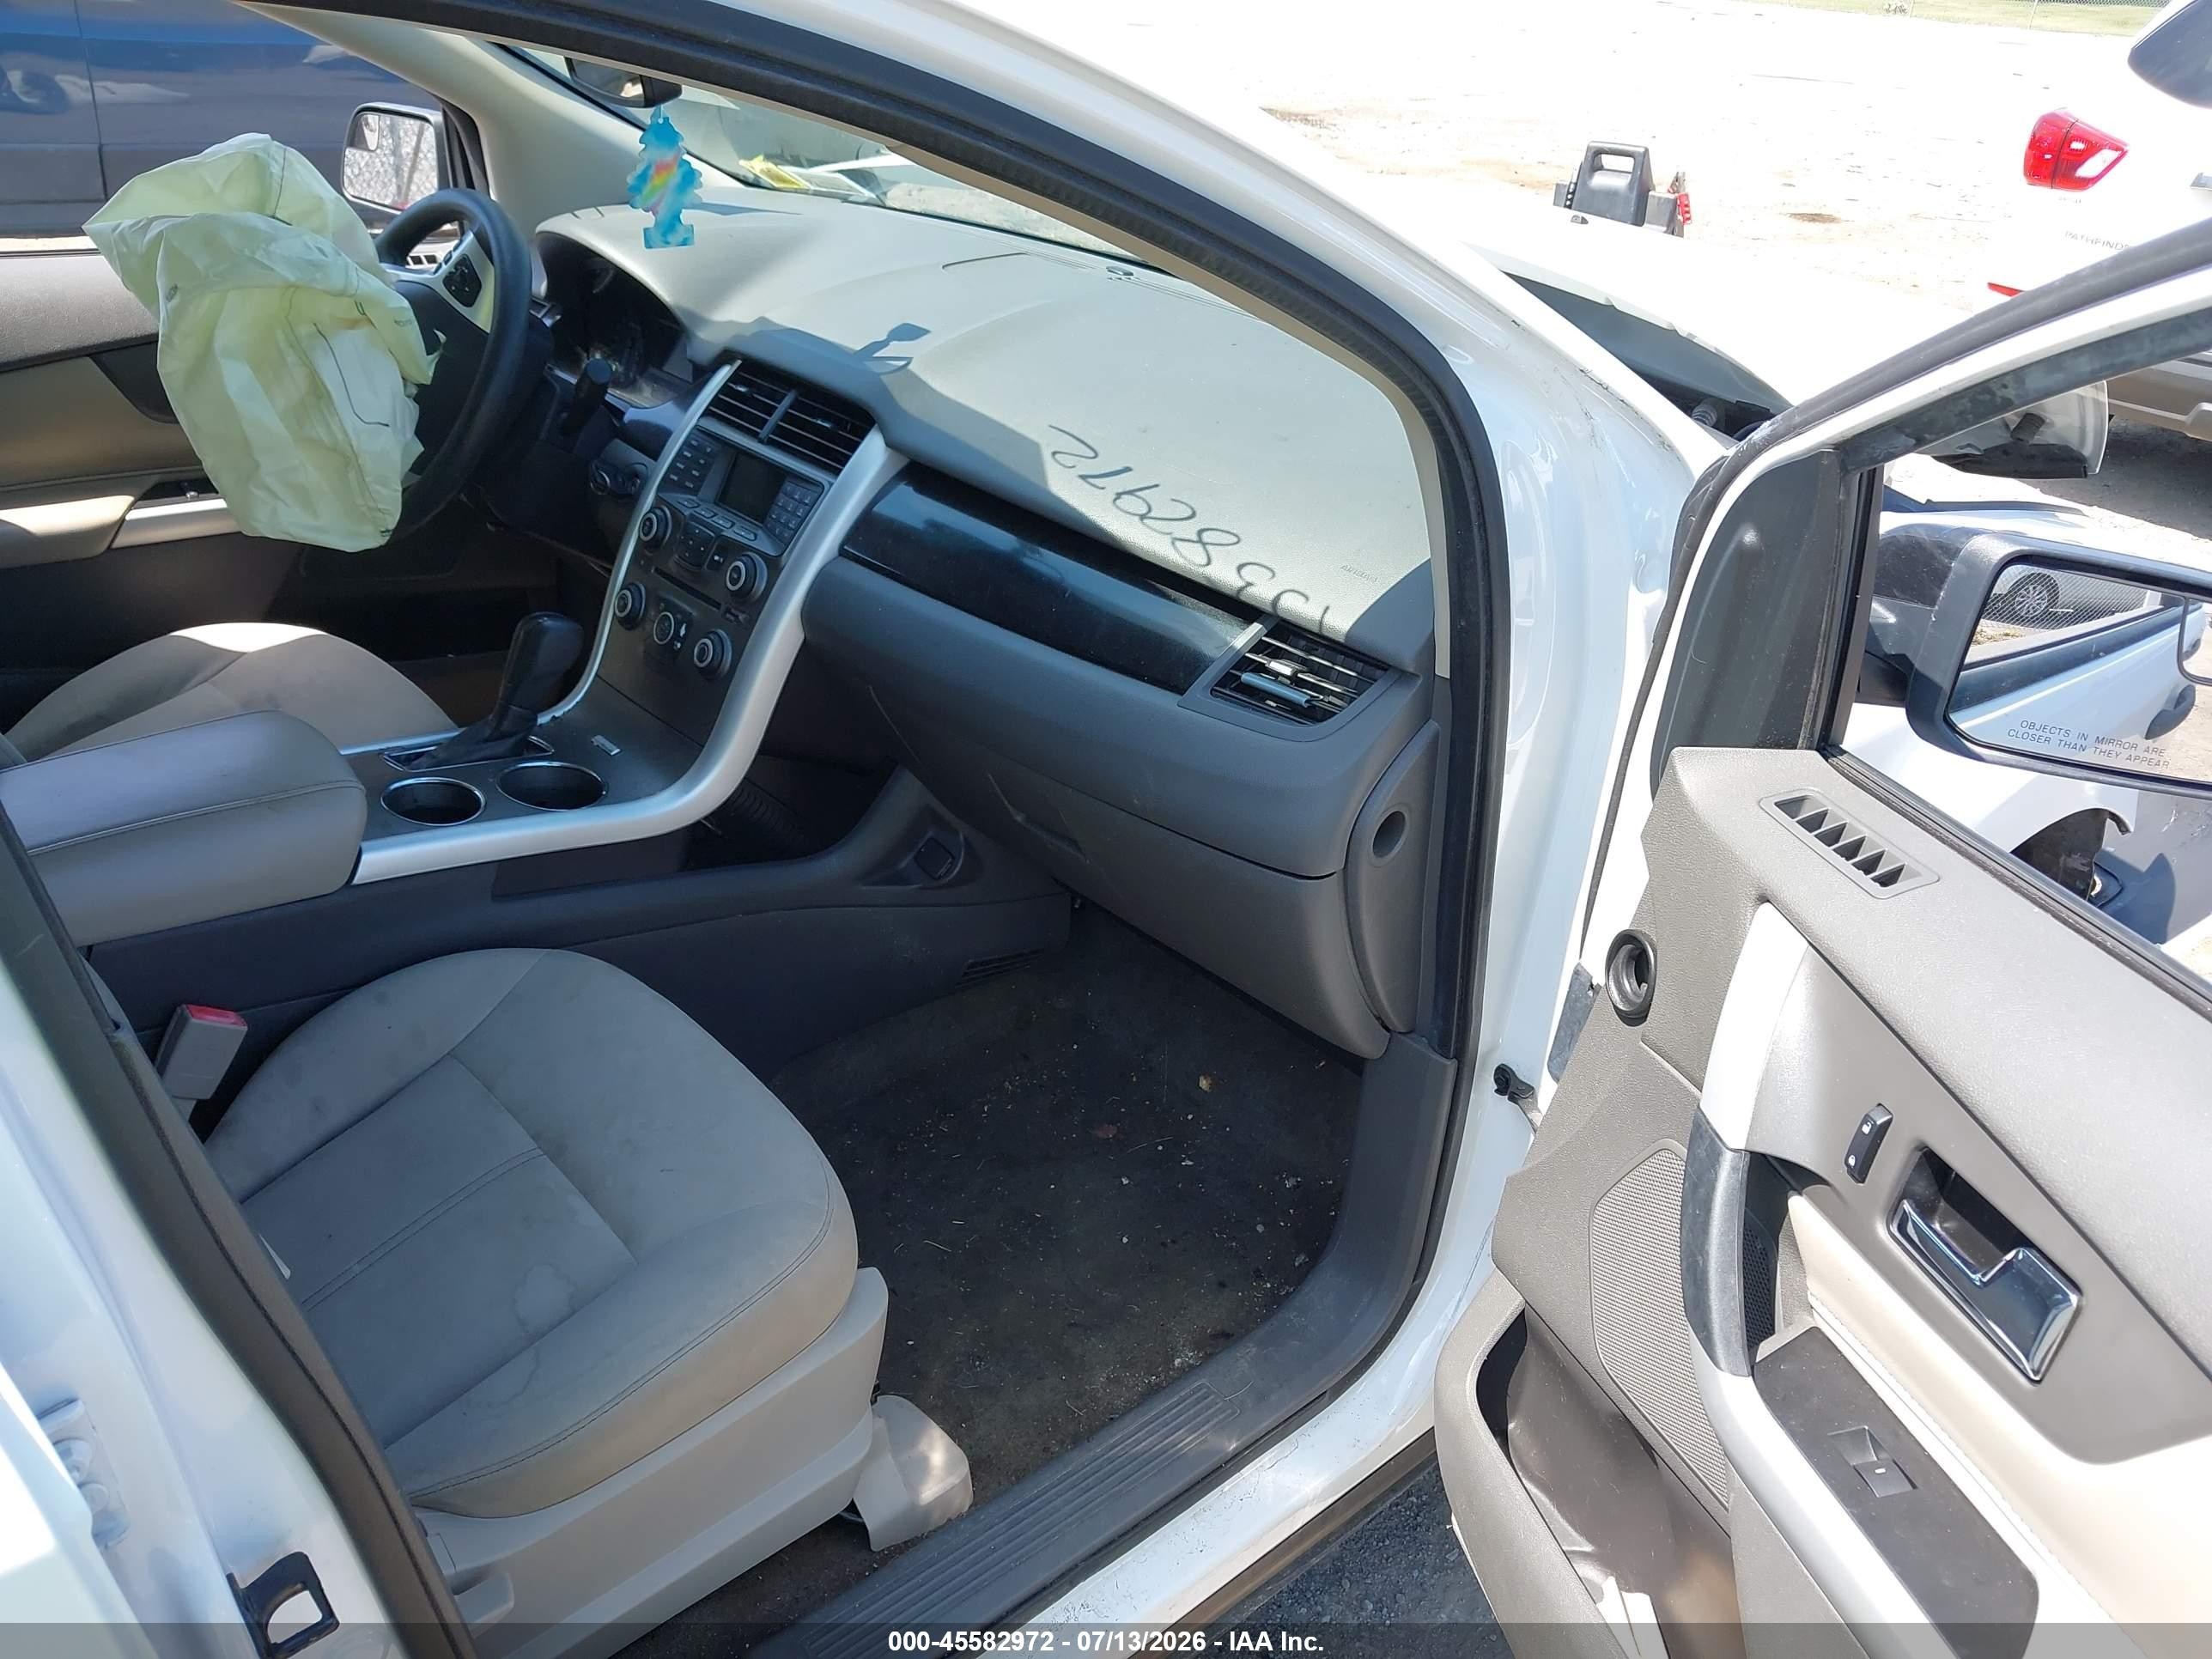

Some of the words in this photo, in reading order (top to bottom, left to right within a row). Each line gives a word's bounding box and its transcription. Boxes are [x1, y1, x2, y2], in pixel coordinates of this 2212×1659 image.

[2008, 728, 2051, 744] CLOSER
[2057, 738, 2087, 752] THAN
[2094, 746, 2122, 759] THEY
[2125, 754, 2170, 769] APPEAR
[2021, 720, 2071, 738] OBJECTS
[2076, 732, 2088, 741] IN
[2094, 736, 2138, 750] MIRROR
[2143, 745, 2166, 757] ARE
